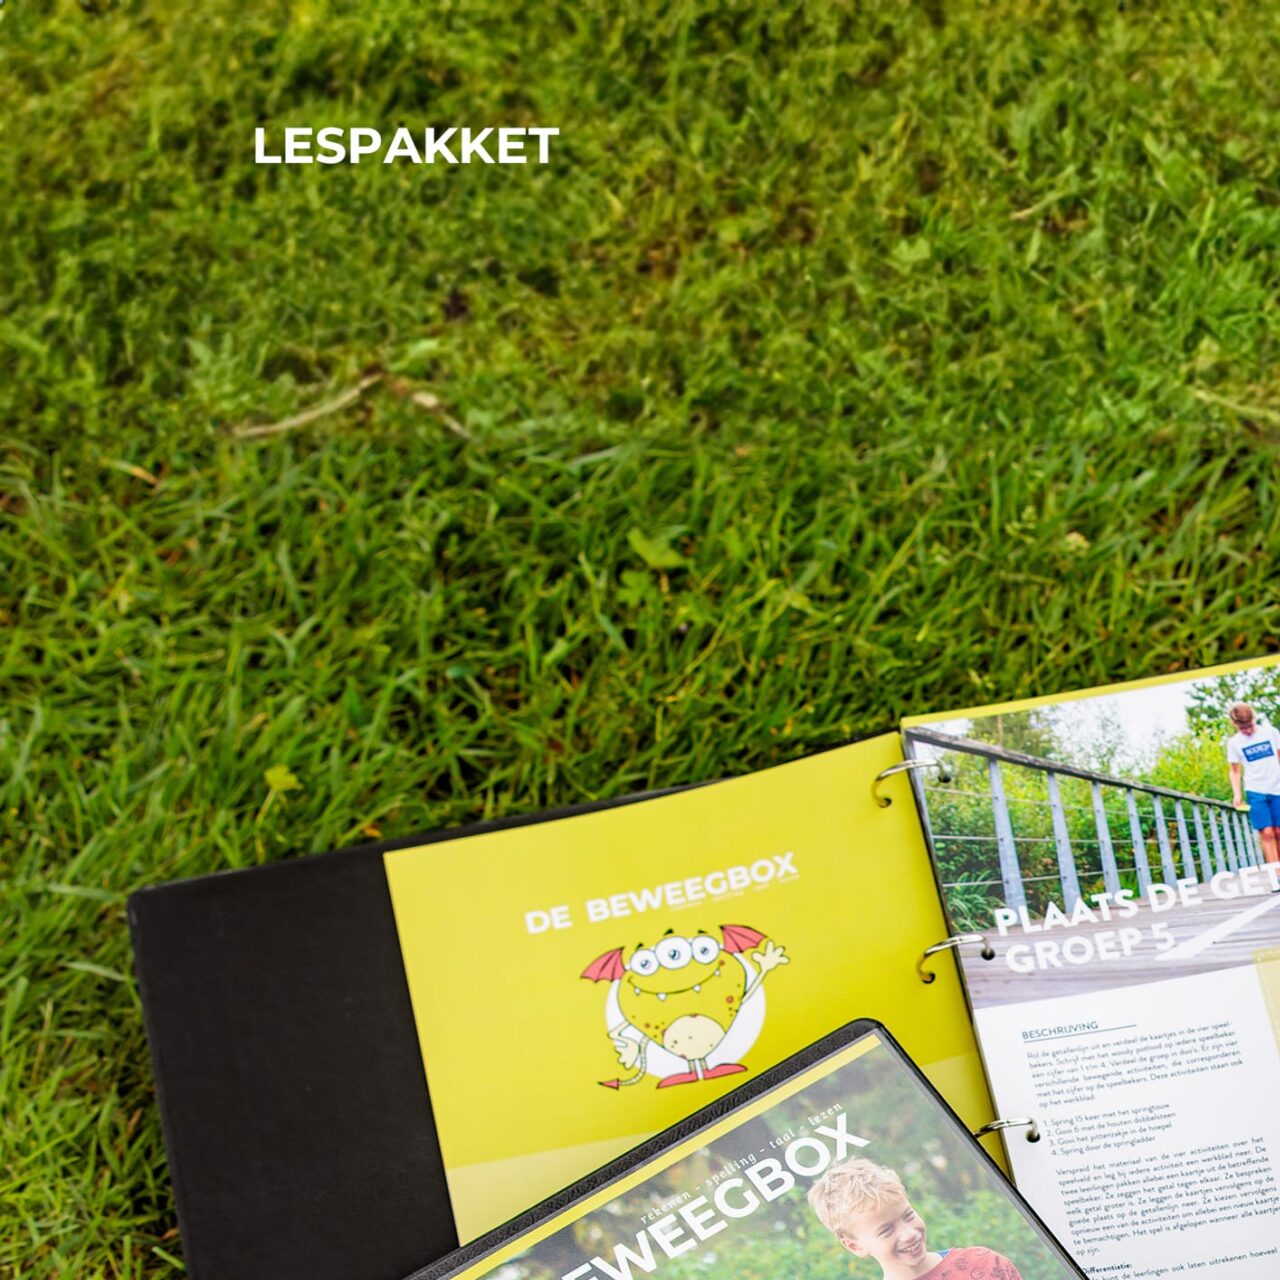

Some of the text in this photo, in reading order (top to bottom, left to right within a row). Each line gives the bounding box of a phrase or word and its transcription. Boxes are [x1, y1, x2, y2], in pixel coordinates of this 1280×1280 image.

[524, 904, 572, 934] DE
[586, 852, 797, 921] BEWEEGBOX
[995, 889, 1139, 936] PLAATS
[1149, 878, 1200, 915] DE
[1005, 922, 1176, 974] GROEP 5
[1021, 1021, 1099, 1040] BESCHRIJVING
[640, 1190, 691, 1224] rekenen
[704, 1150, 757, 1191] spelling
[769, 1128, 796, 1150] taal
[808, 1102, 843, 1127] lezen
